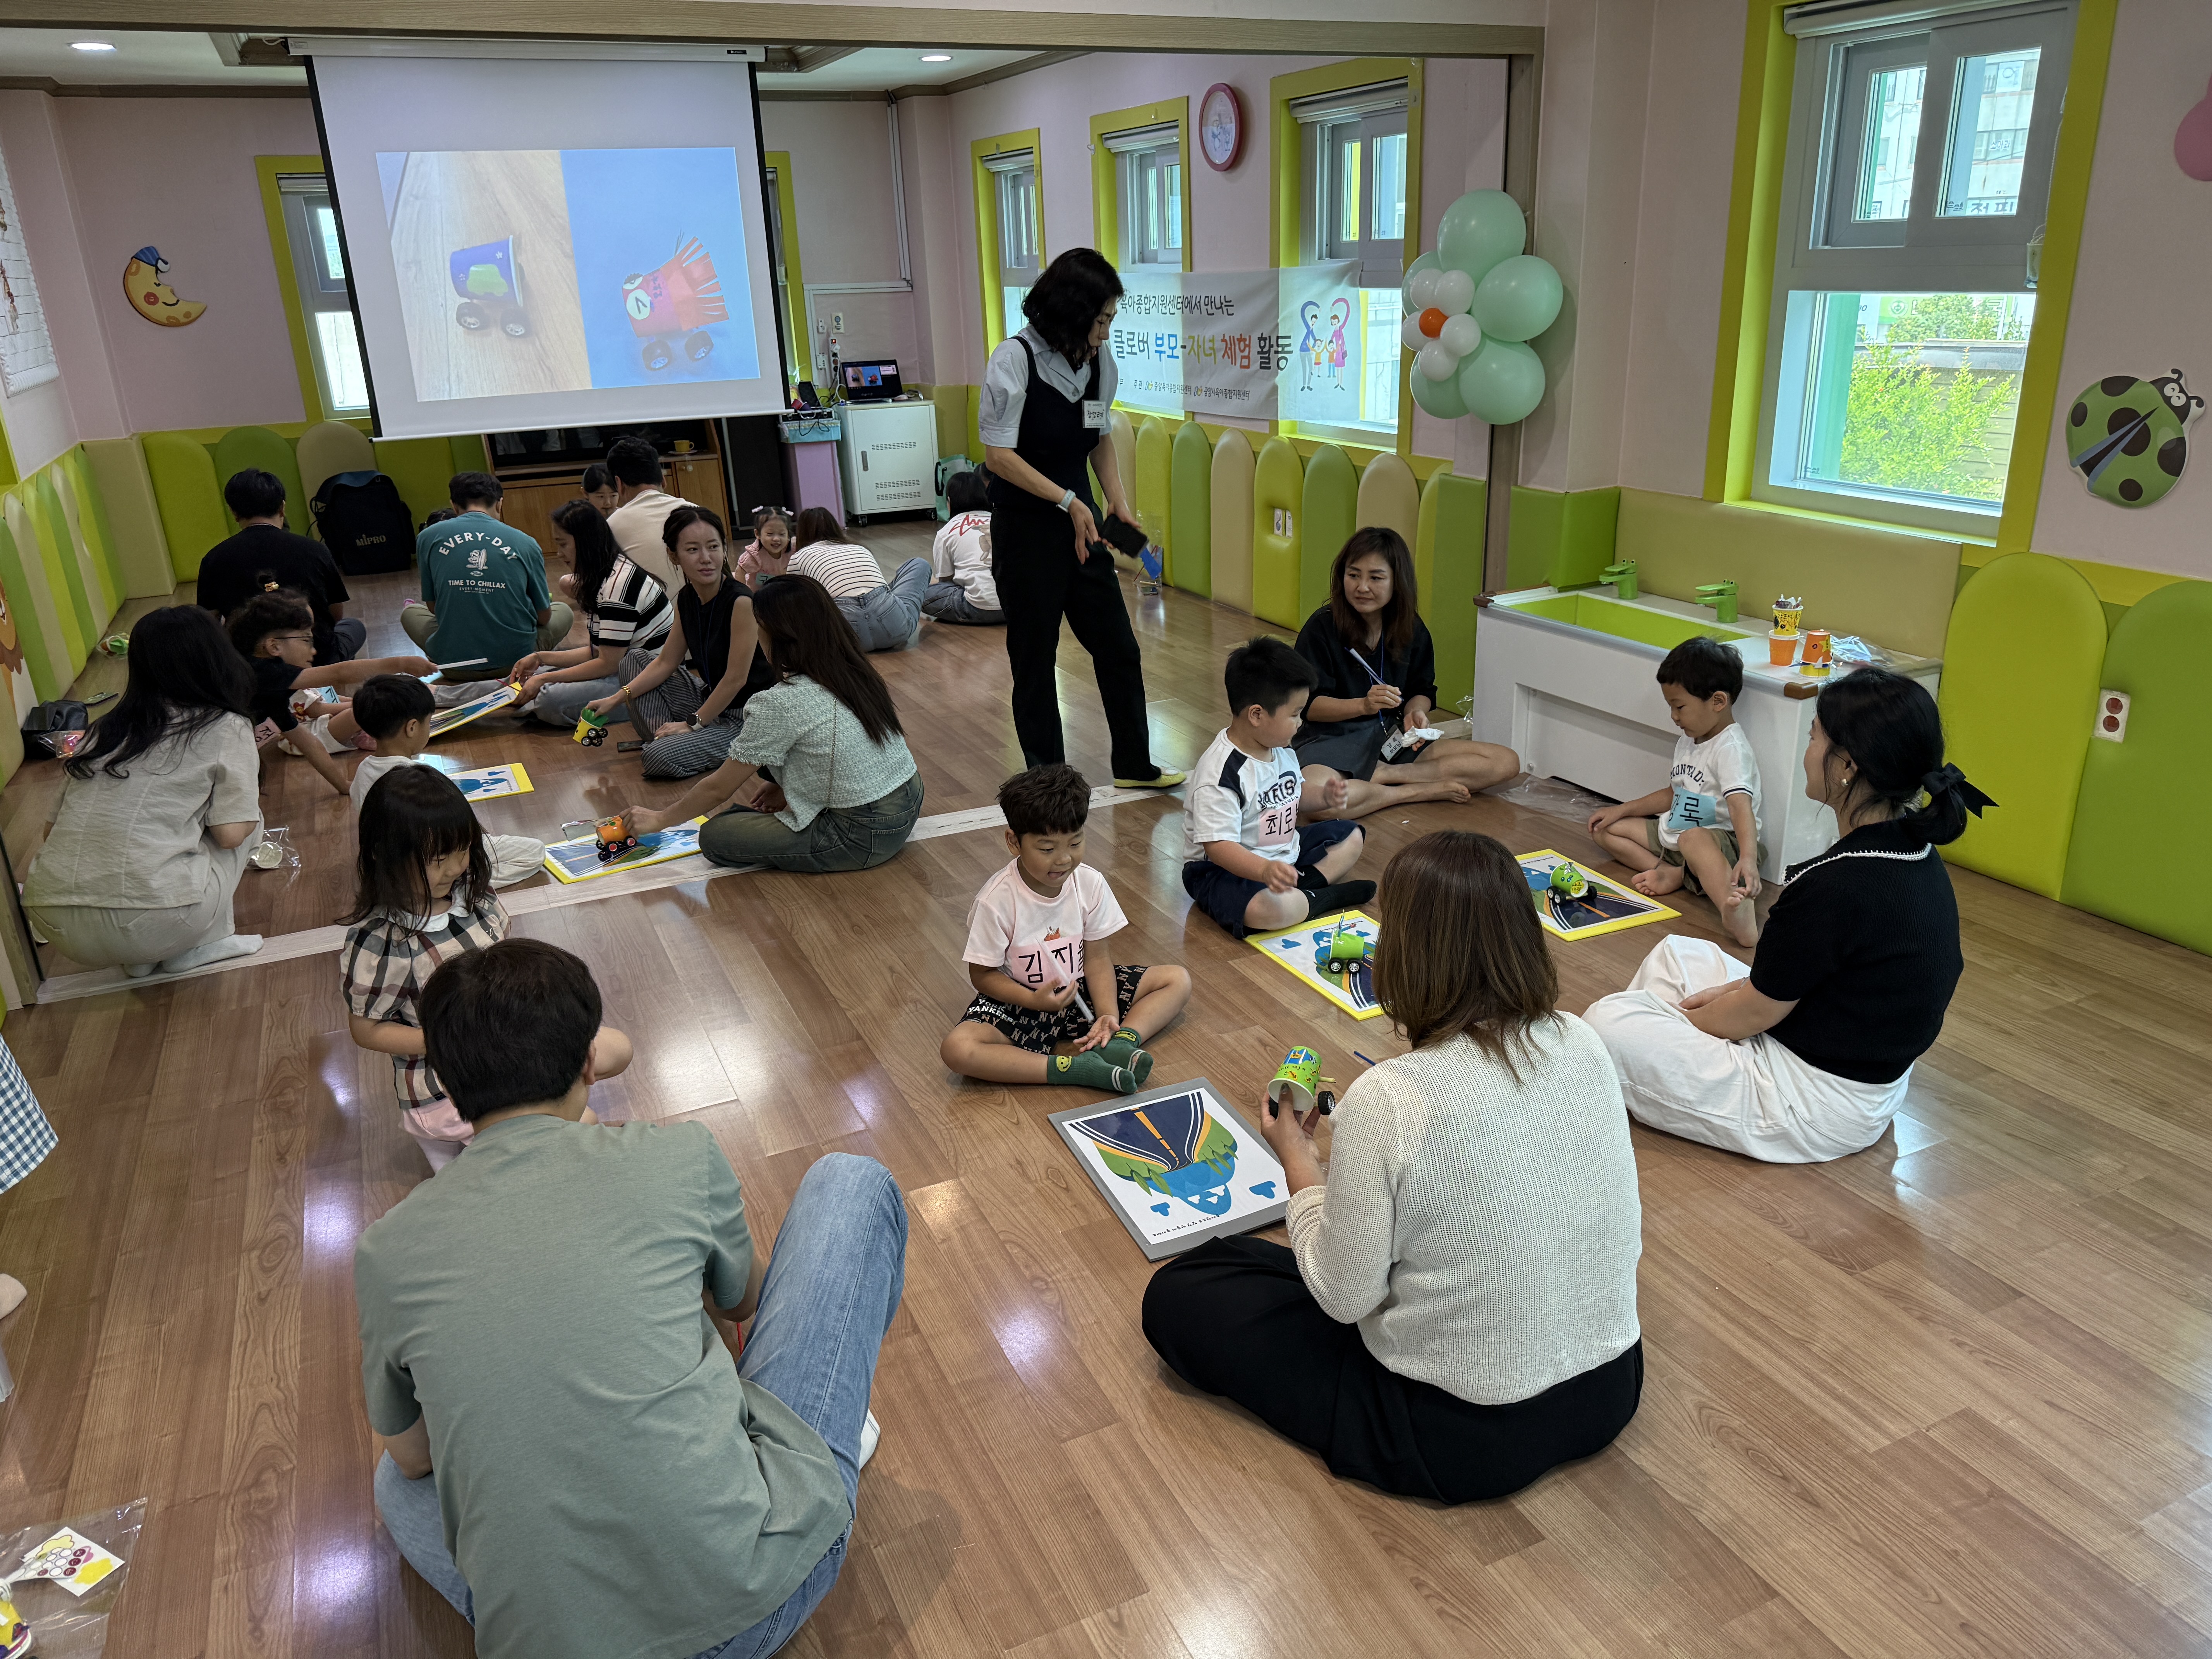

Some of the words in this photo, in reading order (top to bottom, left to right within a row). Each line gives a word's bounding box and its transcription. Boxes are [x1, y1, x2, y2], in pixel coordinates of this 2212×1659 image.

[1204, 295, 1235, 316] 만나는
[1114, 330, 1150, 360] 클로버
[1154, 333, 1216, 365] 부모-자녀
[1221, 333, 1252, 369] 체험
[1257, 333, 1293, 371] 활동
[439, 532, 518, 560] EVERY-DAY
[477, 580, 505, 589] CHILLAX
[1670, 764, 1704, 787] MONTAU
[979, 999, 1006, 1012] YORK
